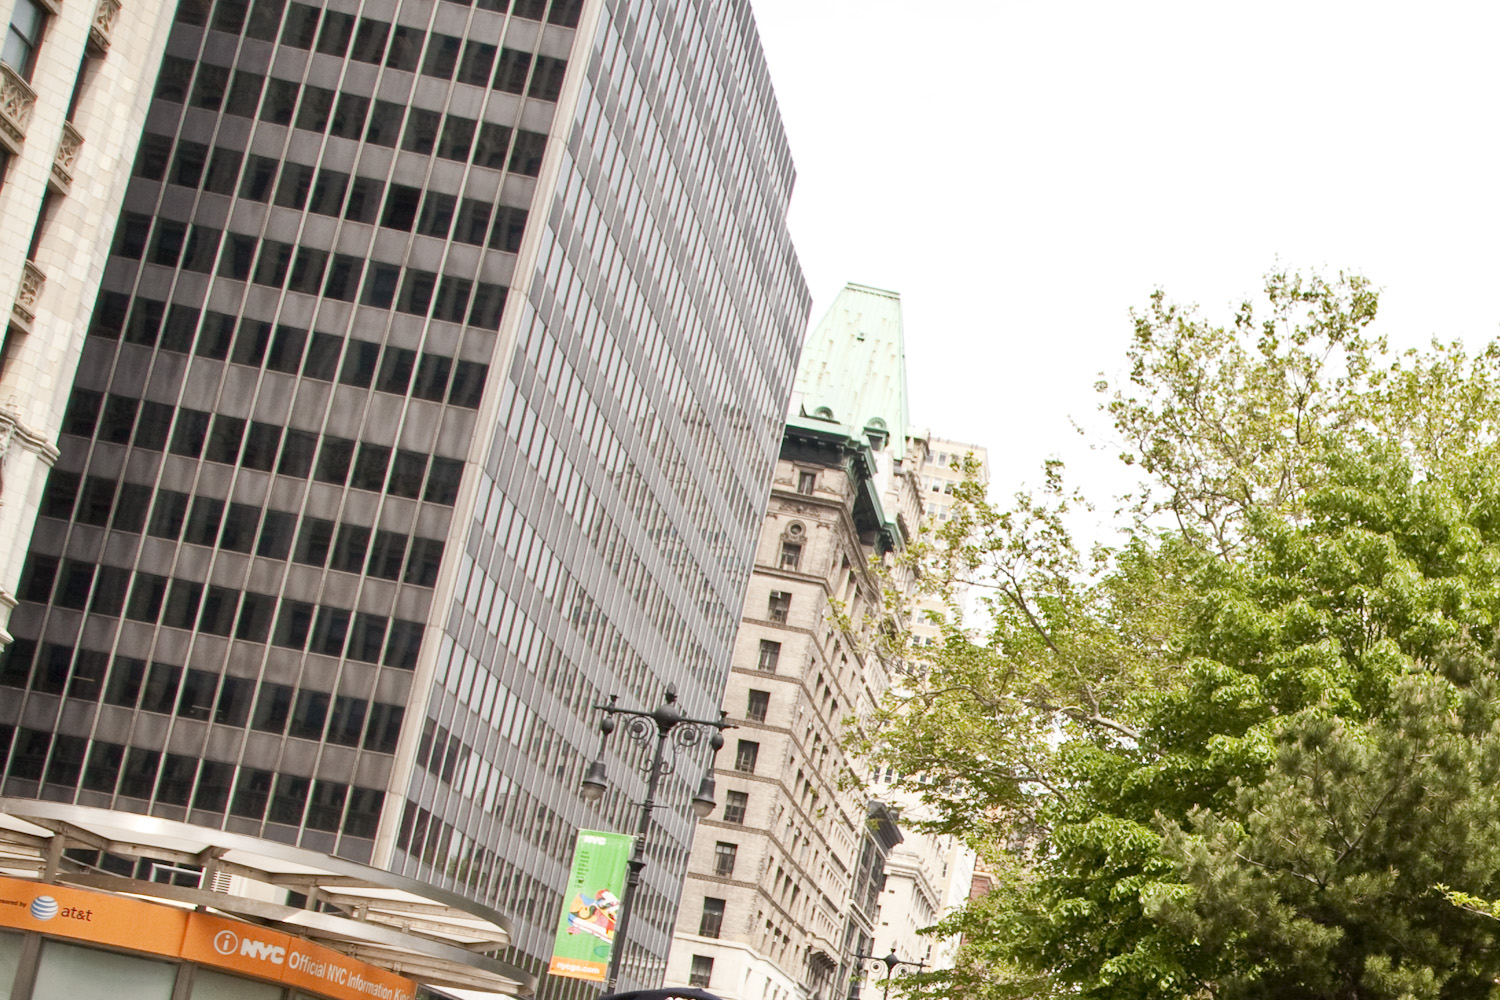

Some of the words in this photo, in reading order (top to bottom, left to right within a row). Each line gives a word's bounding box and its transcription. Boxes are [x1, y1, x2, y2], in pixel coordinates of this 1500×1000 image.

[61, 907, 93, 922] at&t
[240, 938, 286, 964] NYC
[289, 951, 325, 978] Official
[327, 963, 348, 986] NYC
[347, 970, 393, 1000] Information
[556, 962, 600, 974] nycgo.com
